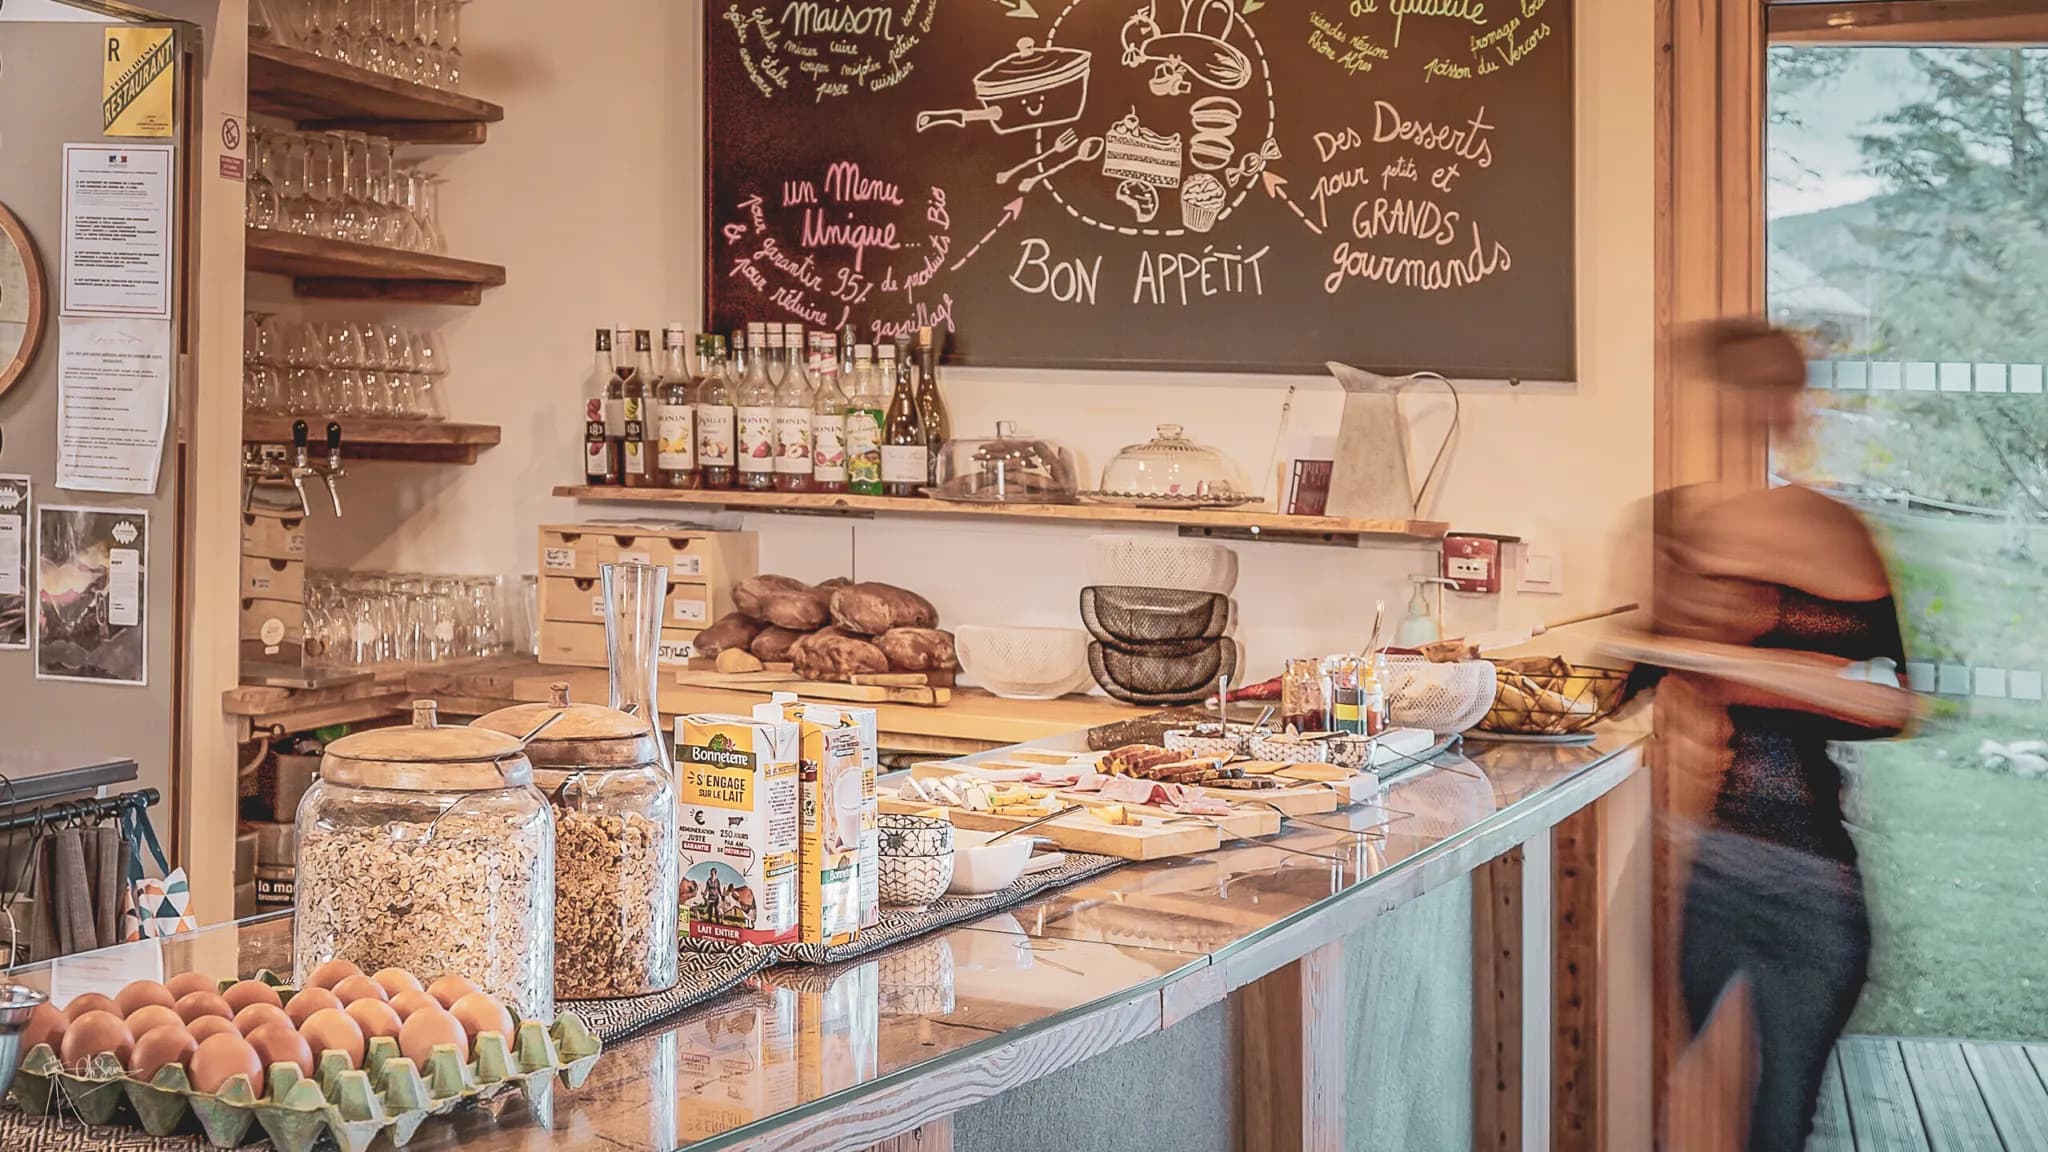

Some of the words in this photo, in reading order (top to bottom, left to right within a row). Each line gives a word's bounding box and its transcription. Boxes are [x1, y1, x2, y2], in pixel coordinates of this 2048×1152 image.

[108, 37, 120, 62] R
[1478, 56, 1499, 75] du
[104, 33, 174, 128] RESTAURANT
[1373, 101, 1494, 168] Desserts
[825, 161, 904, 206] Menu
[1310, 164, 1369, 228] pour
[1381, 156, 1418, 191] petits
[1431, 162, 1460, 193] et
[1352, 198, 1460, 245] GRANDS
[1009, 238, 1102, 305] BON
[1325, 221, 1512, 294] gourmands
[881, 265, 898, 292] de
[692, 747, 748, 765] Bonneterre
[697, 774, 746, 791] S'ENGAGE
[713, 790, 721, 799] LE
[723, 790, 744, 803] LAIT
[697, 925, 712, 935] LAIT
[715, 927, 740, 939] ENTIER
